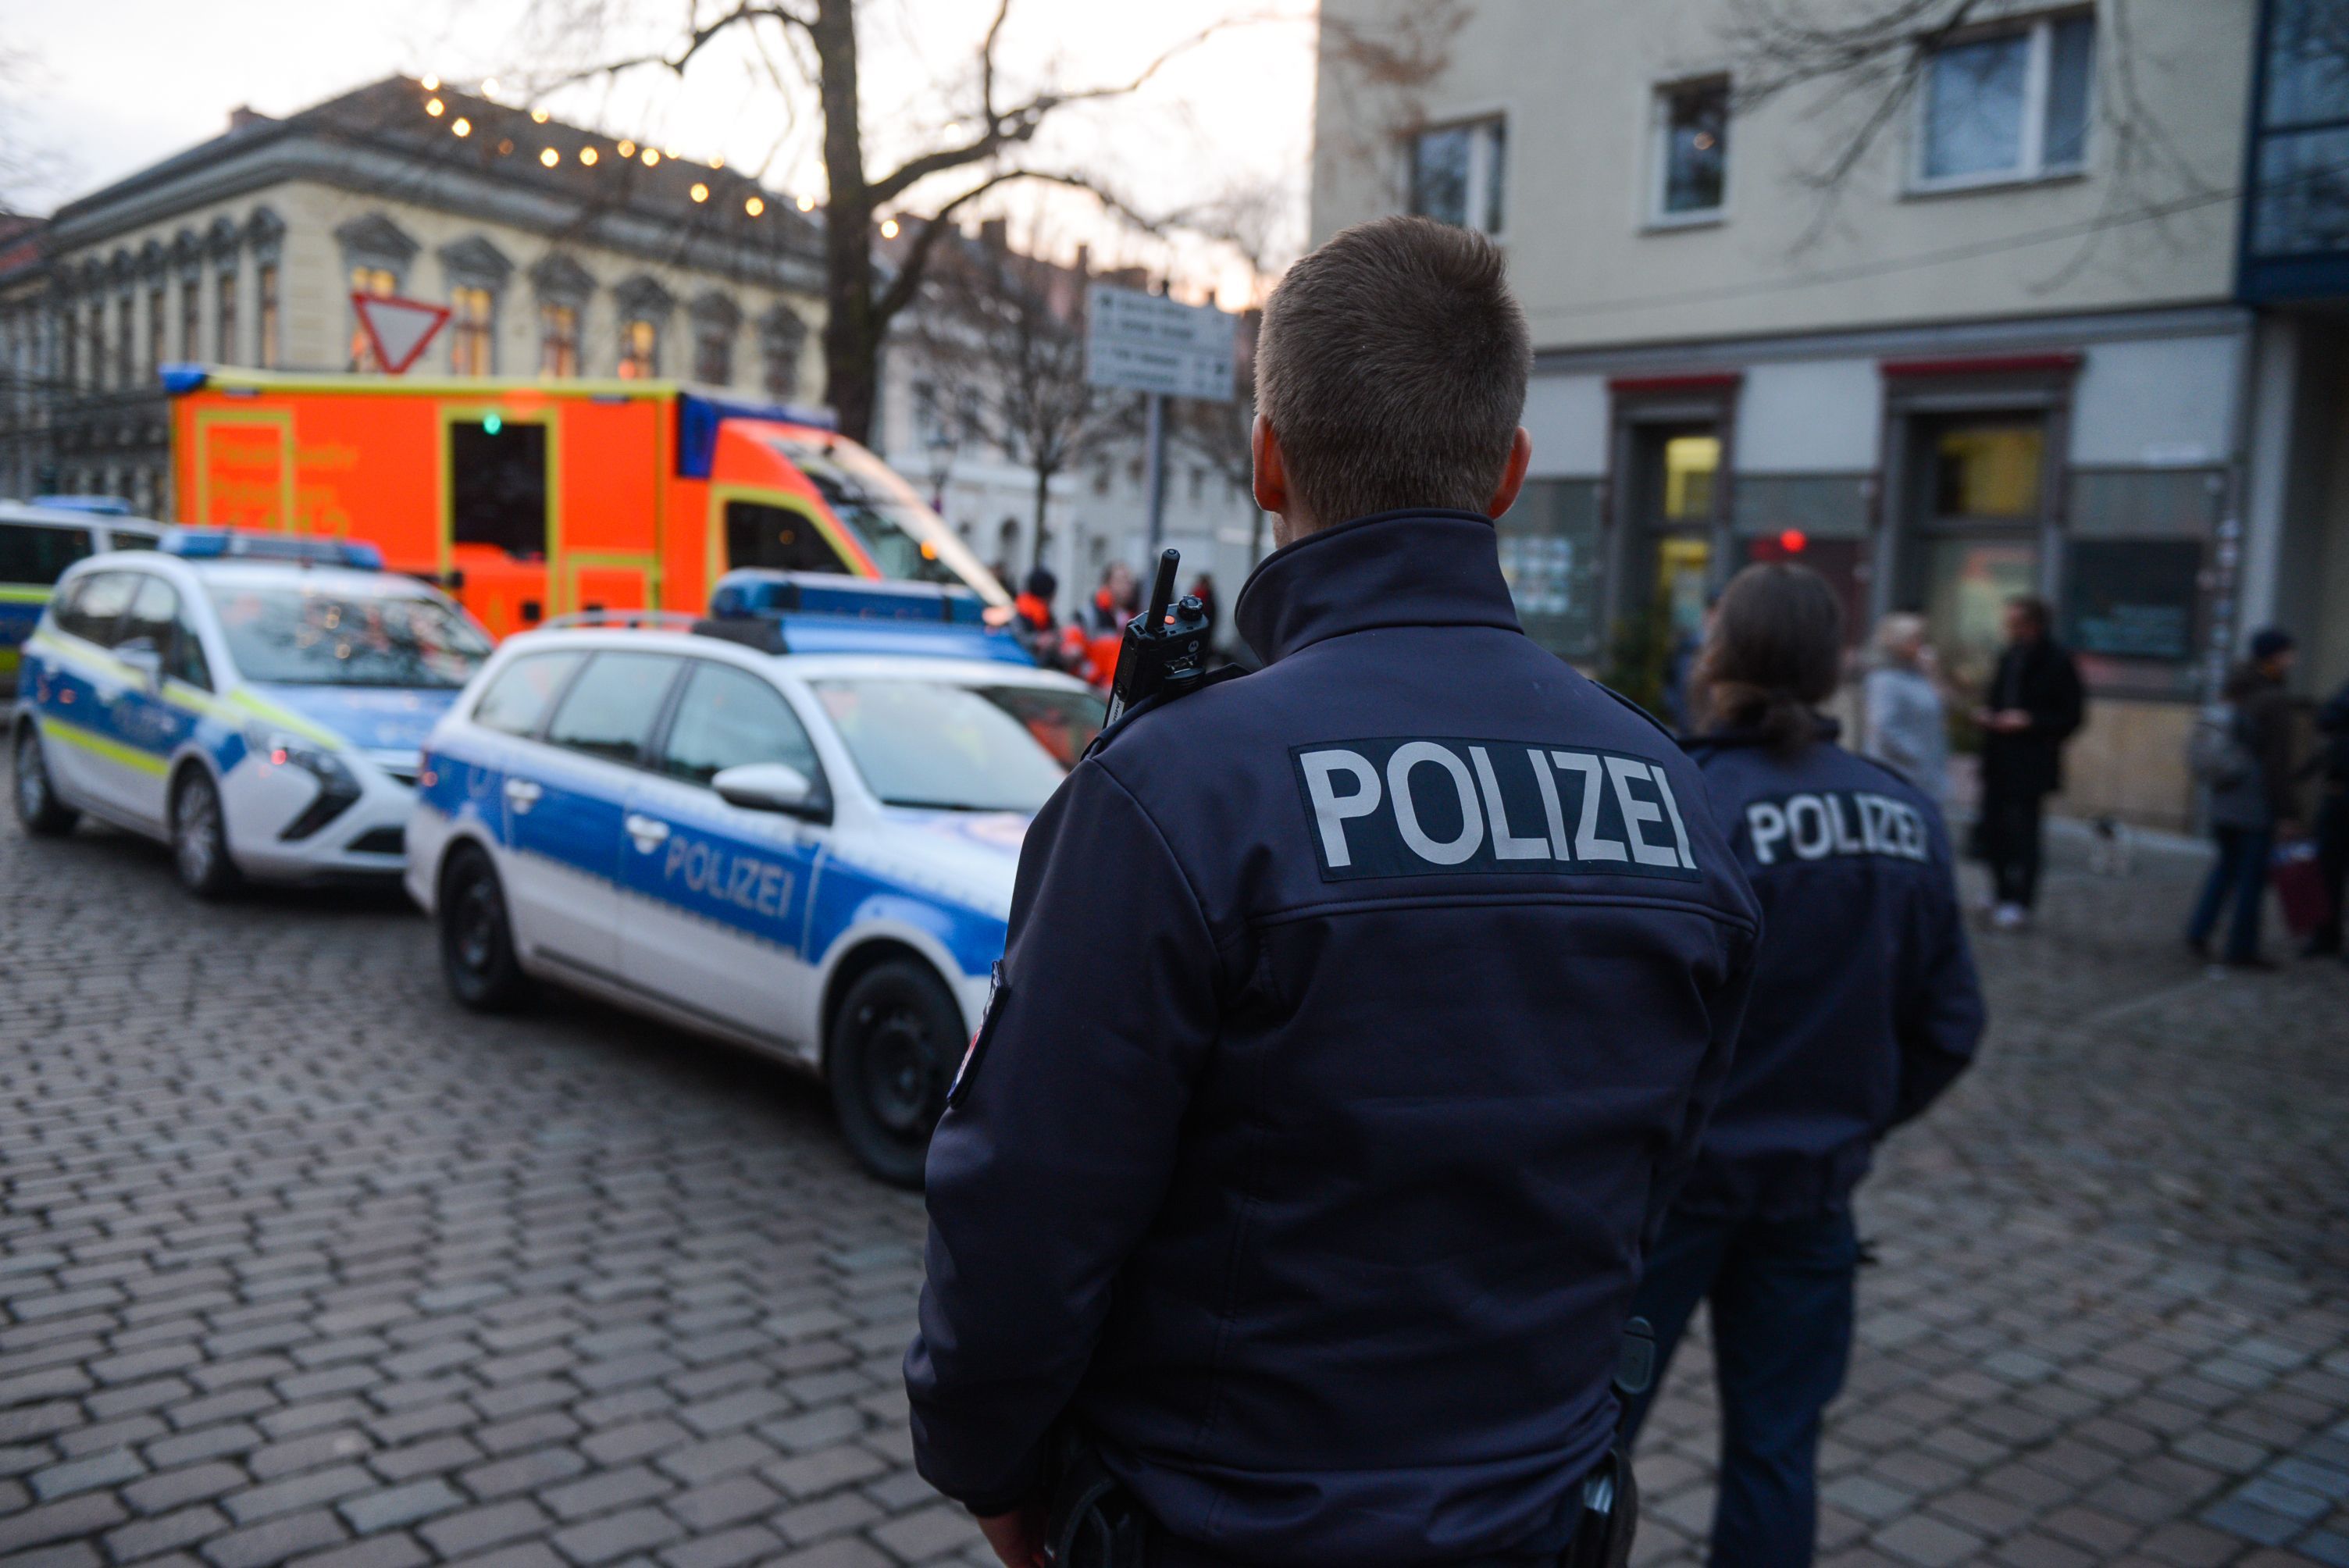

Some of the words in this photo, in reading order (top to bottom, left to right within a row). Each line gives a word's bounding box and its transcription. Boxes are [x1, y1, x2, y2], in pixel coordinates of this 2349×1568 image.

[1299, 741, 1698, 868] POLIZEI
[1746, 792, 1929, 864] POLIZEI
[664, 834, 795, 918] POLIZEI
